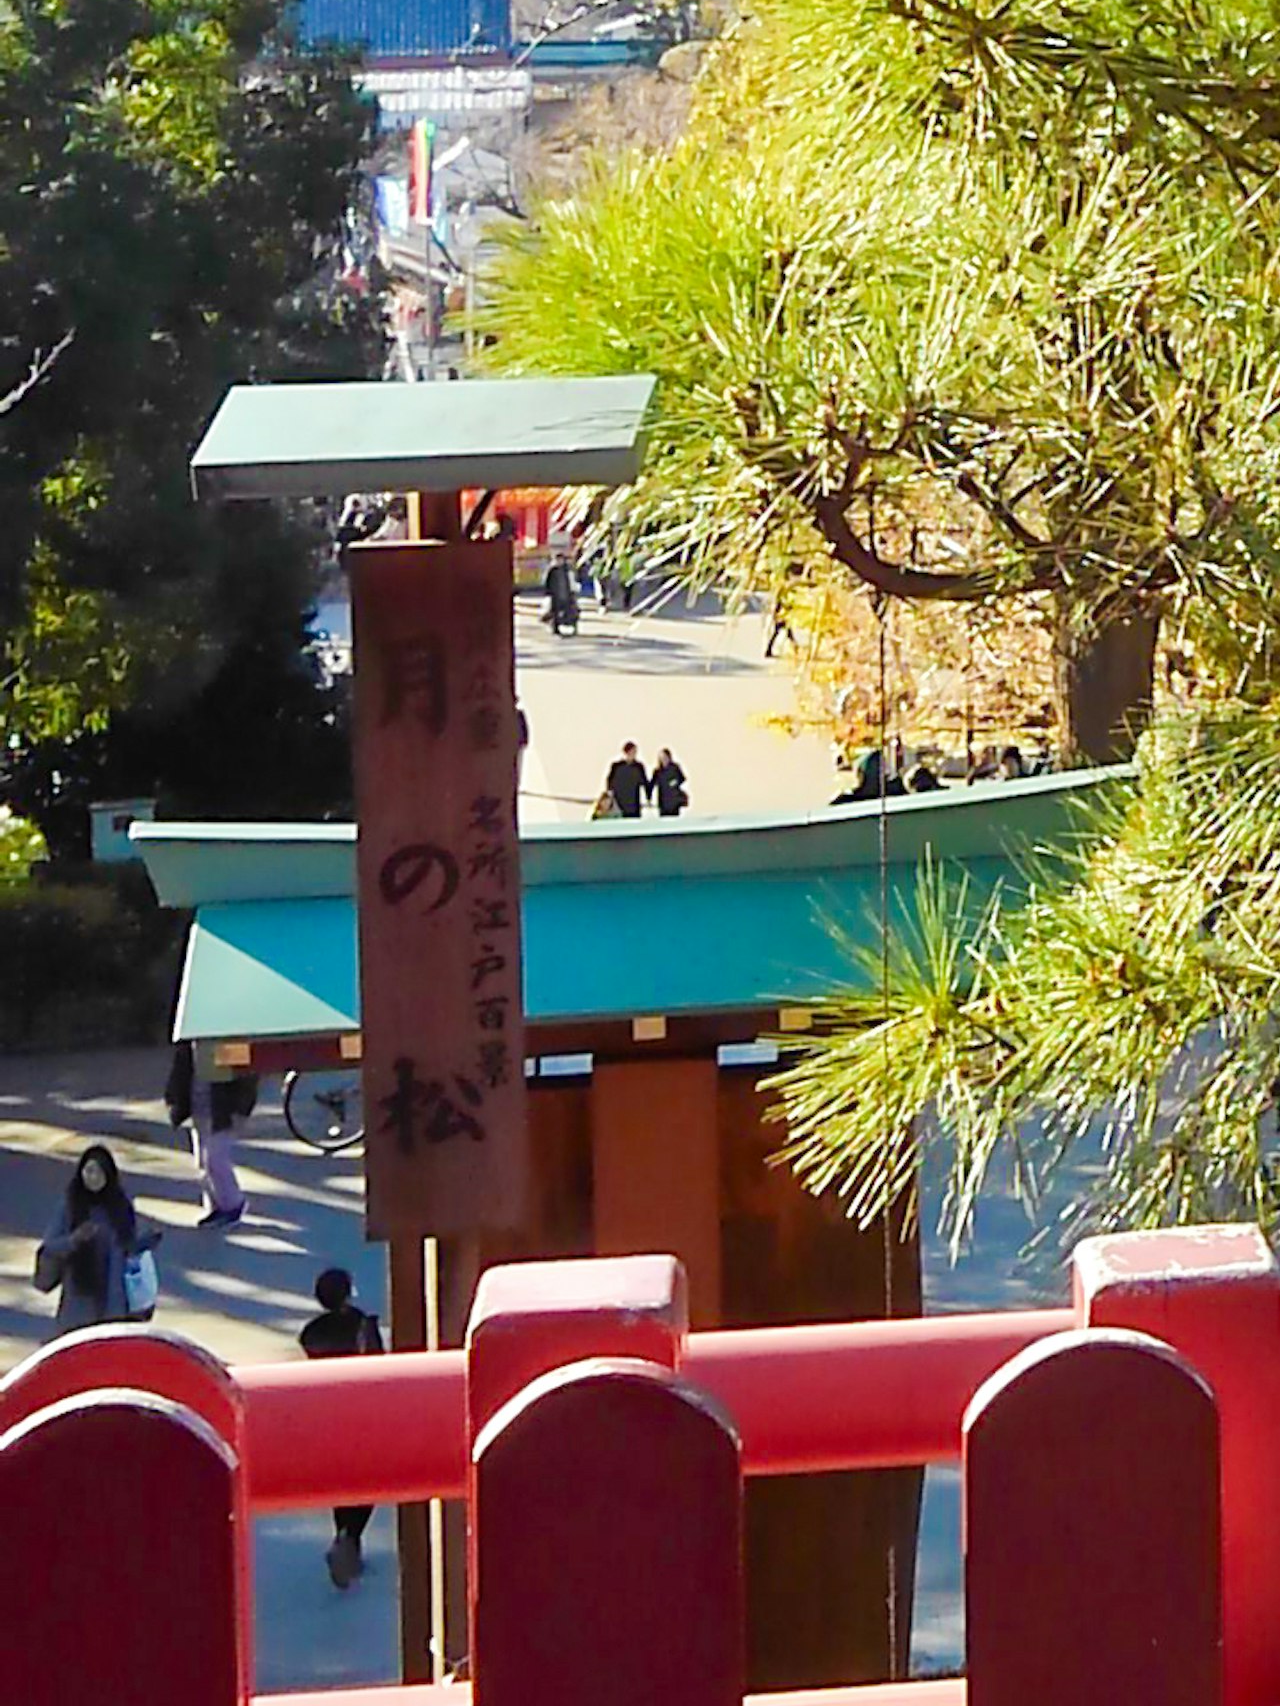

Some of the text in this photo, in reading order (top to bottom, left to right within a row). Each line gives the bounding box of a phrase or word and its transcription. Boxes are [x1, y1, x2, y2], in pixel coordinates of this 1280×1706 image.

[379, 633, 486, 1152] 月の松
[467, 794, 511, 1088] 名所江戸百景
